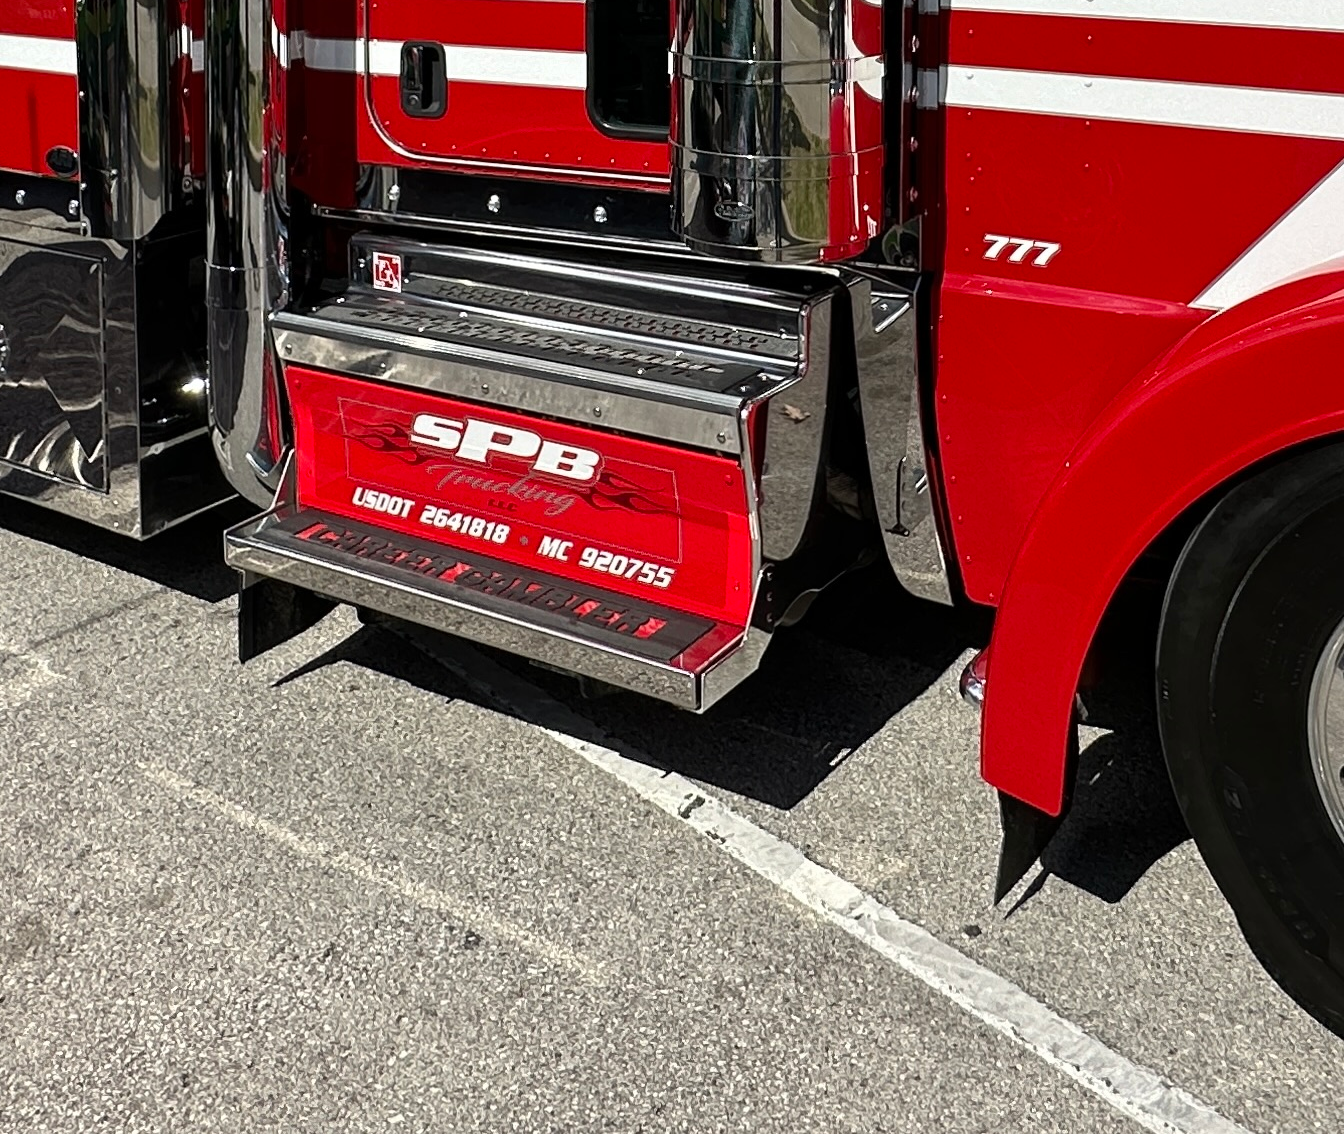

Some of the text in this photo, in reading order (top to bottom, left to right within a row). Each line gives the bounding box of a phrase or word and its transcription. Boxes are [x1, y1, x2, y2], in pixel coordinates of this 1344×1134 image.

[983, 233, 1061, 268] 777
[409, 413, 602, 482] SPB
[426, 464, 577, 517] Trucking
[352, 486, 676, 589] USDOT 2641818 MC 920755
